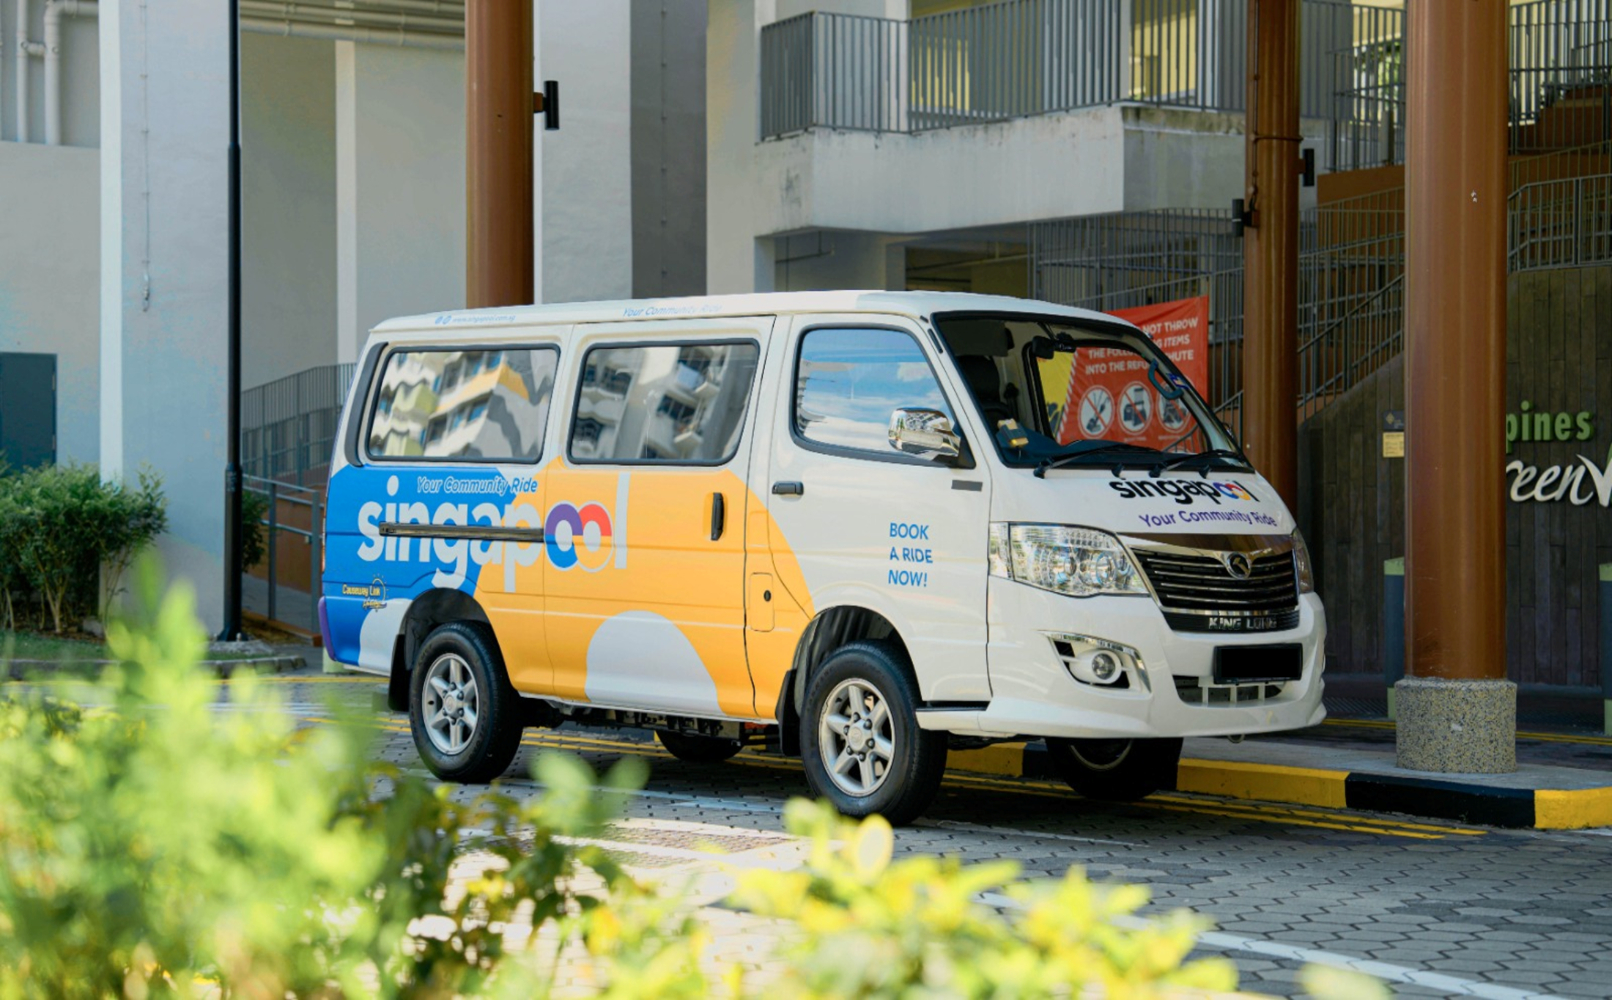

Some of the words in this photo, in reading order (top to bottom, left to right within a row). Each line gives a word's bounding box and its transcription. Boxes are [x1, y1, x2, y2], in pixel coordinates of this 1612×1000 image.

[622, 307, 644, 317] Your
[645, 305, 695, 317] Community
[1164, 317, 1198, 332] THROW
[1088, 349, 1105, 360] THE
[1164, 333, 1190, 348] ITEMS
[1085, 363, 1107, 376] INTO
[1108, 361, 1125, 373] THE
[416, 475, 443, 494] Your
[443, 475, 508, 497] Community
[510, 476, 538, 493] Ride
[1108, 477, 1260, 505] singapool
[1138, 513, 1176, 528] Your
[1178, 509, 1252, 526] Community
[1251, 511, 1278, 527] Ride
[357, 472, 631, 593] singapool
[889, 522, 929, 540] BOOK
[889, 546, 900, 561] A
[902, 547, 933, 563] RIDE
[888, 569, 928, 587] NOW!
[1208, 617, 1241, 630] KING
[1246, 617, 1277, 630] LONG
